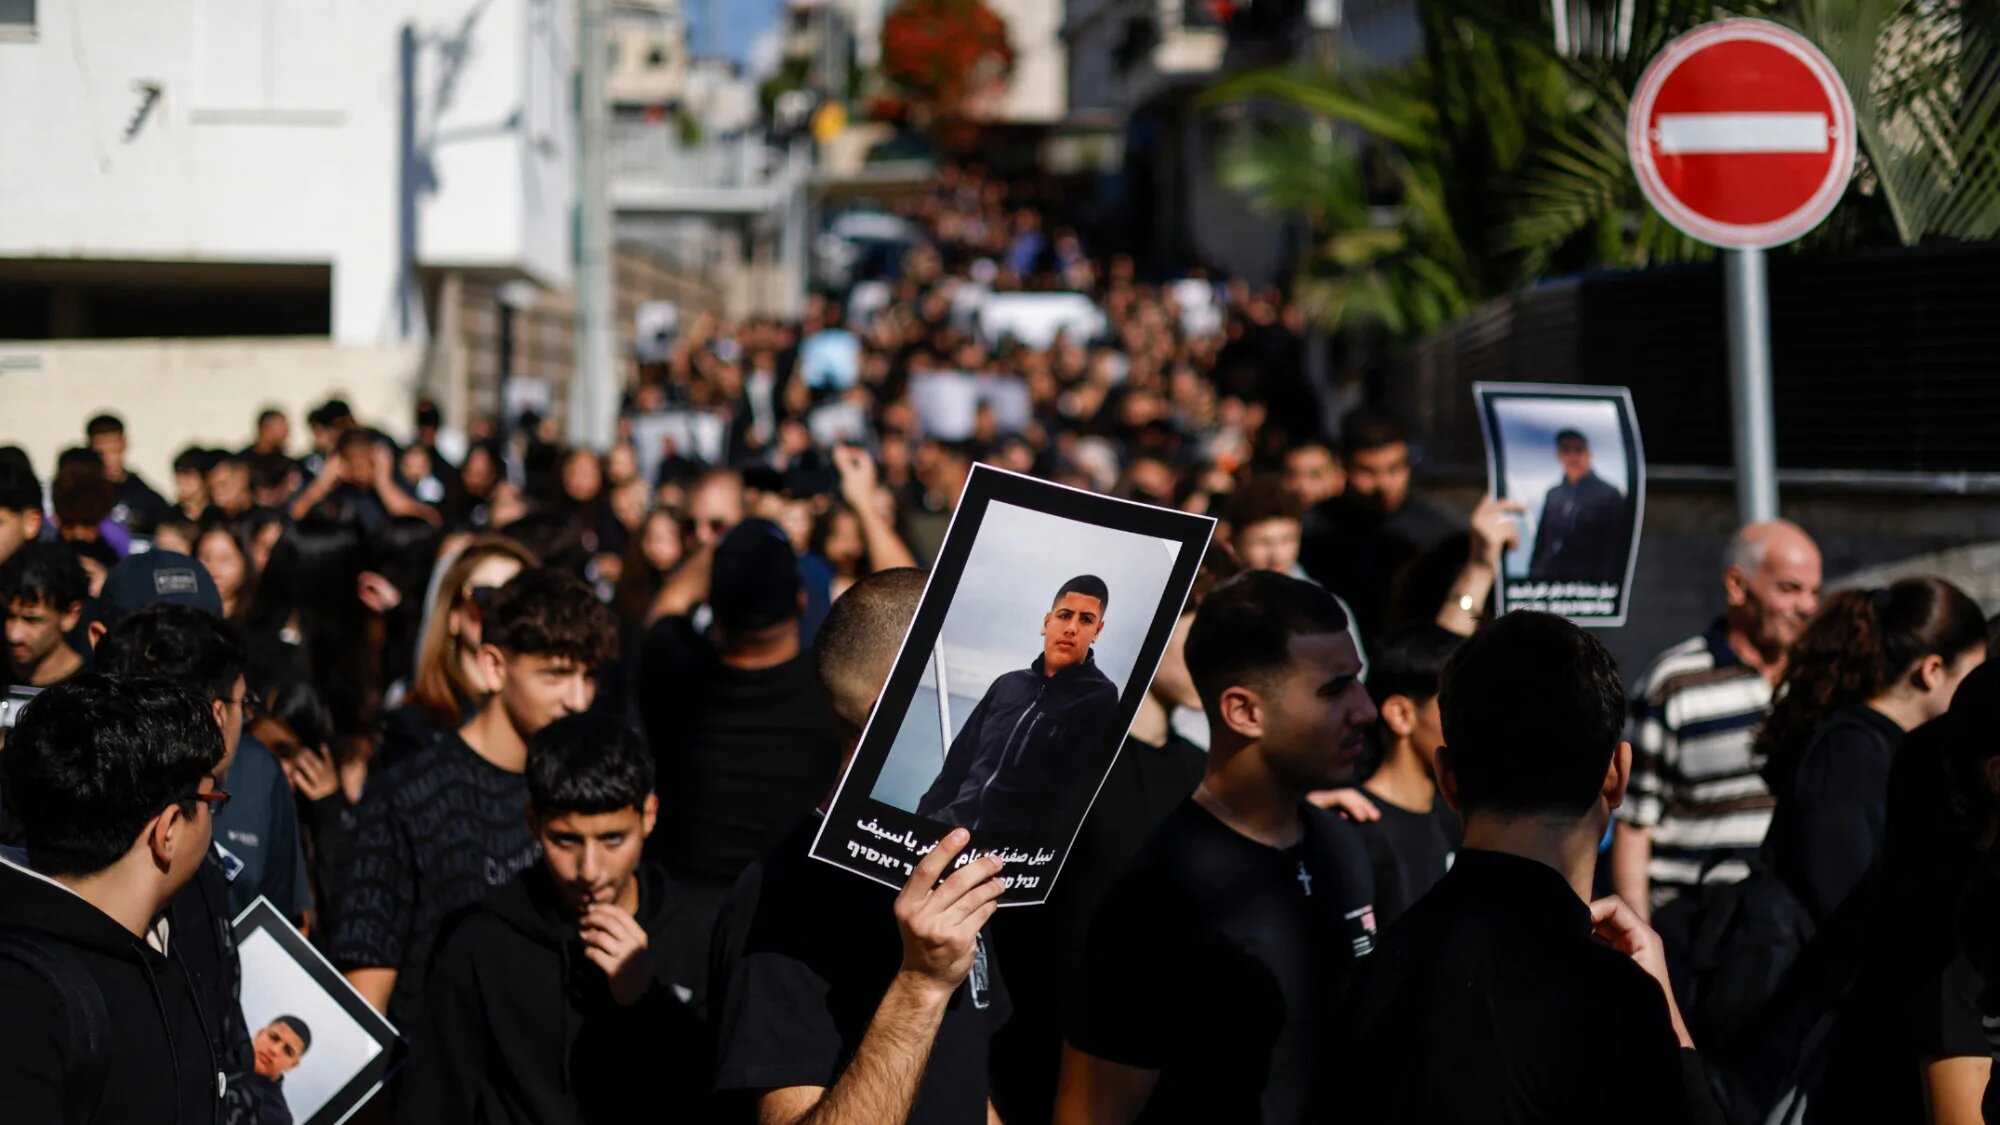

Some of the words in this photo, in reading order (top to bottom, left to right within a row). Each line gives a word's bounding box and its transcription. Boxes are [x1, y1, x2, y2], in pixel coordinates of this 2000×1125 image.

[847, 840, 901, 868] יאסיף
[1028, 847, 1056, 865] نبيل
[1014, 873, 1040, 889] נביל
